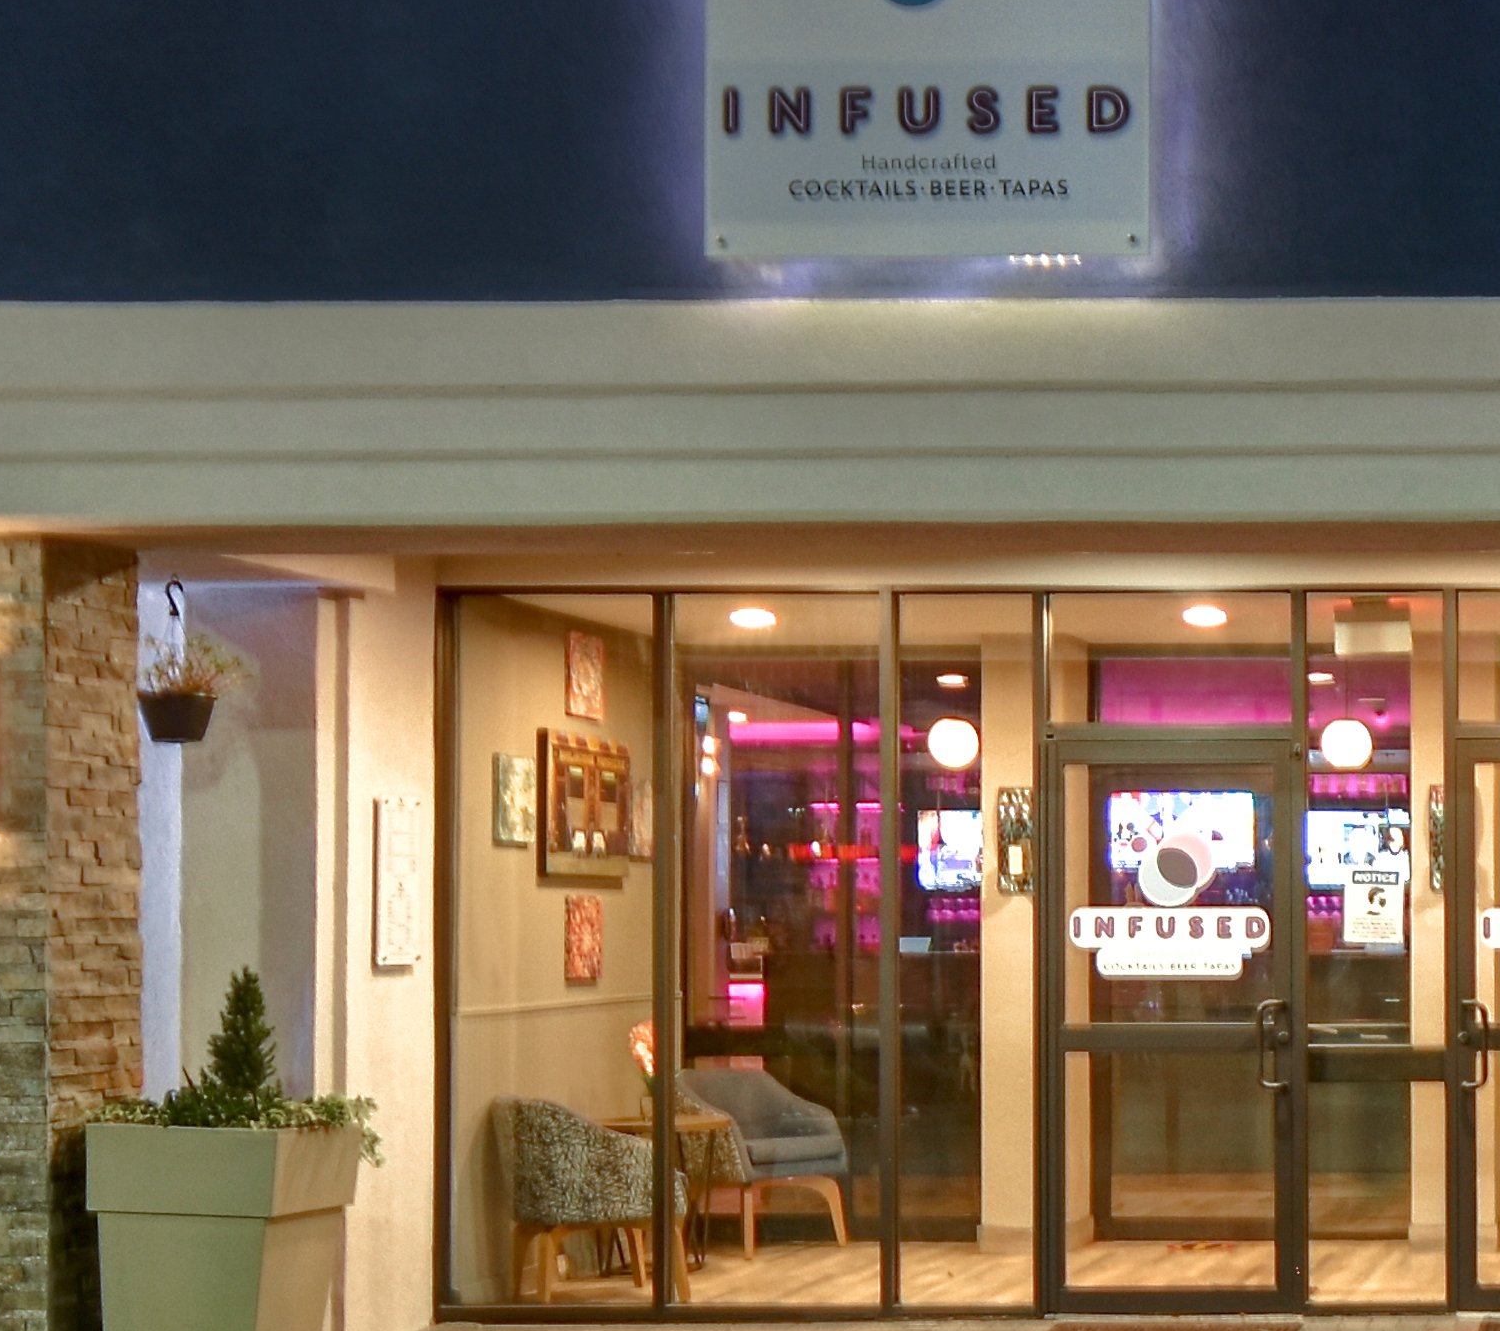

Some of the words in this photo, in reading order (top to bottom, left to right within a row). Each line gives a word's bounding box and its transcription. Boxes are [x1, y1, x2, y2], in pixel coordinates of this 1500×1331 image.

[722, 84, 1132, 137] INFUSED
[860, 153, 997, 171] Handcrafted
[1353, 871, 1397, 883] NOTICE
[1072, 915, 1267, 940] INFUSED
